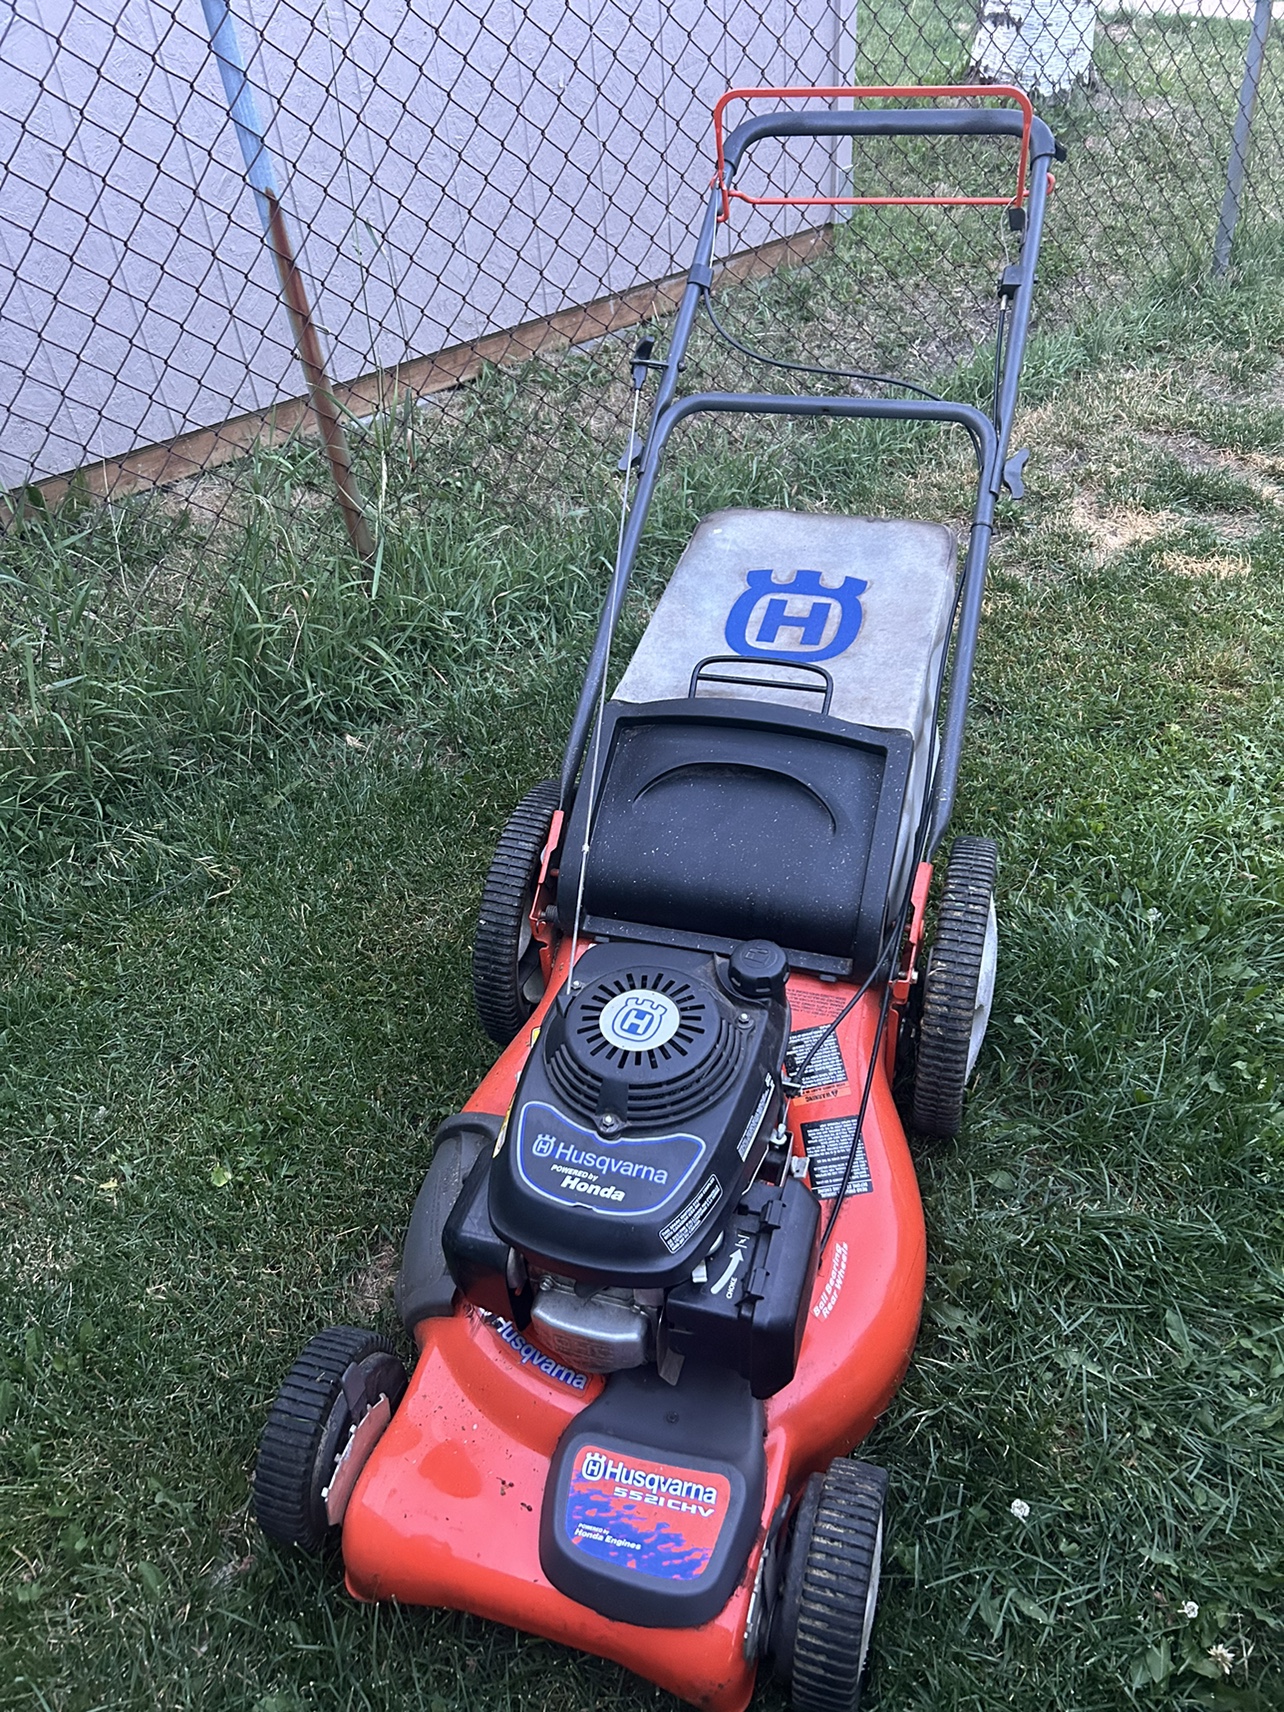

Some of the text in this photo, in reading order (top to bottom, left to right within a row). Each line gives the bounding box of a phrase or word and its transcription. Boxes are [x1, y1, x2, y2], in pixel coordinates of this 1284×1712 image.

[755, 598, 832, 645] H
[551, 1164, 599, 1182] POWERED by
[555, 1142, 669, 1184] Husqvarna
[561, 1175, 626, 1202] Honda
[726, 1277, 737, 1299] CHOKE
[813, 1243, 842, 1318] Ball Bearing
[821, 1241, 848, 1319] Rear Wheels
[604, 1459, 718, 1505] Husqvarna
[574, 1528, 642, 1550] Honda Engines
